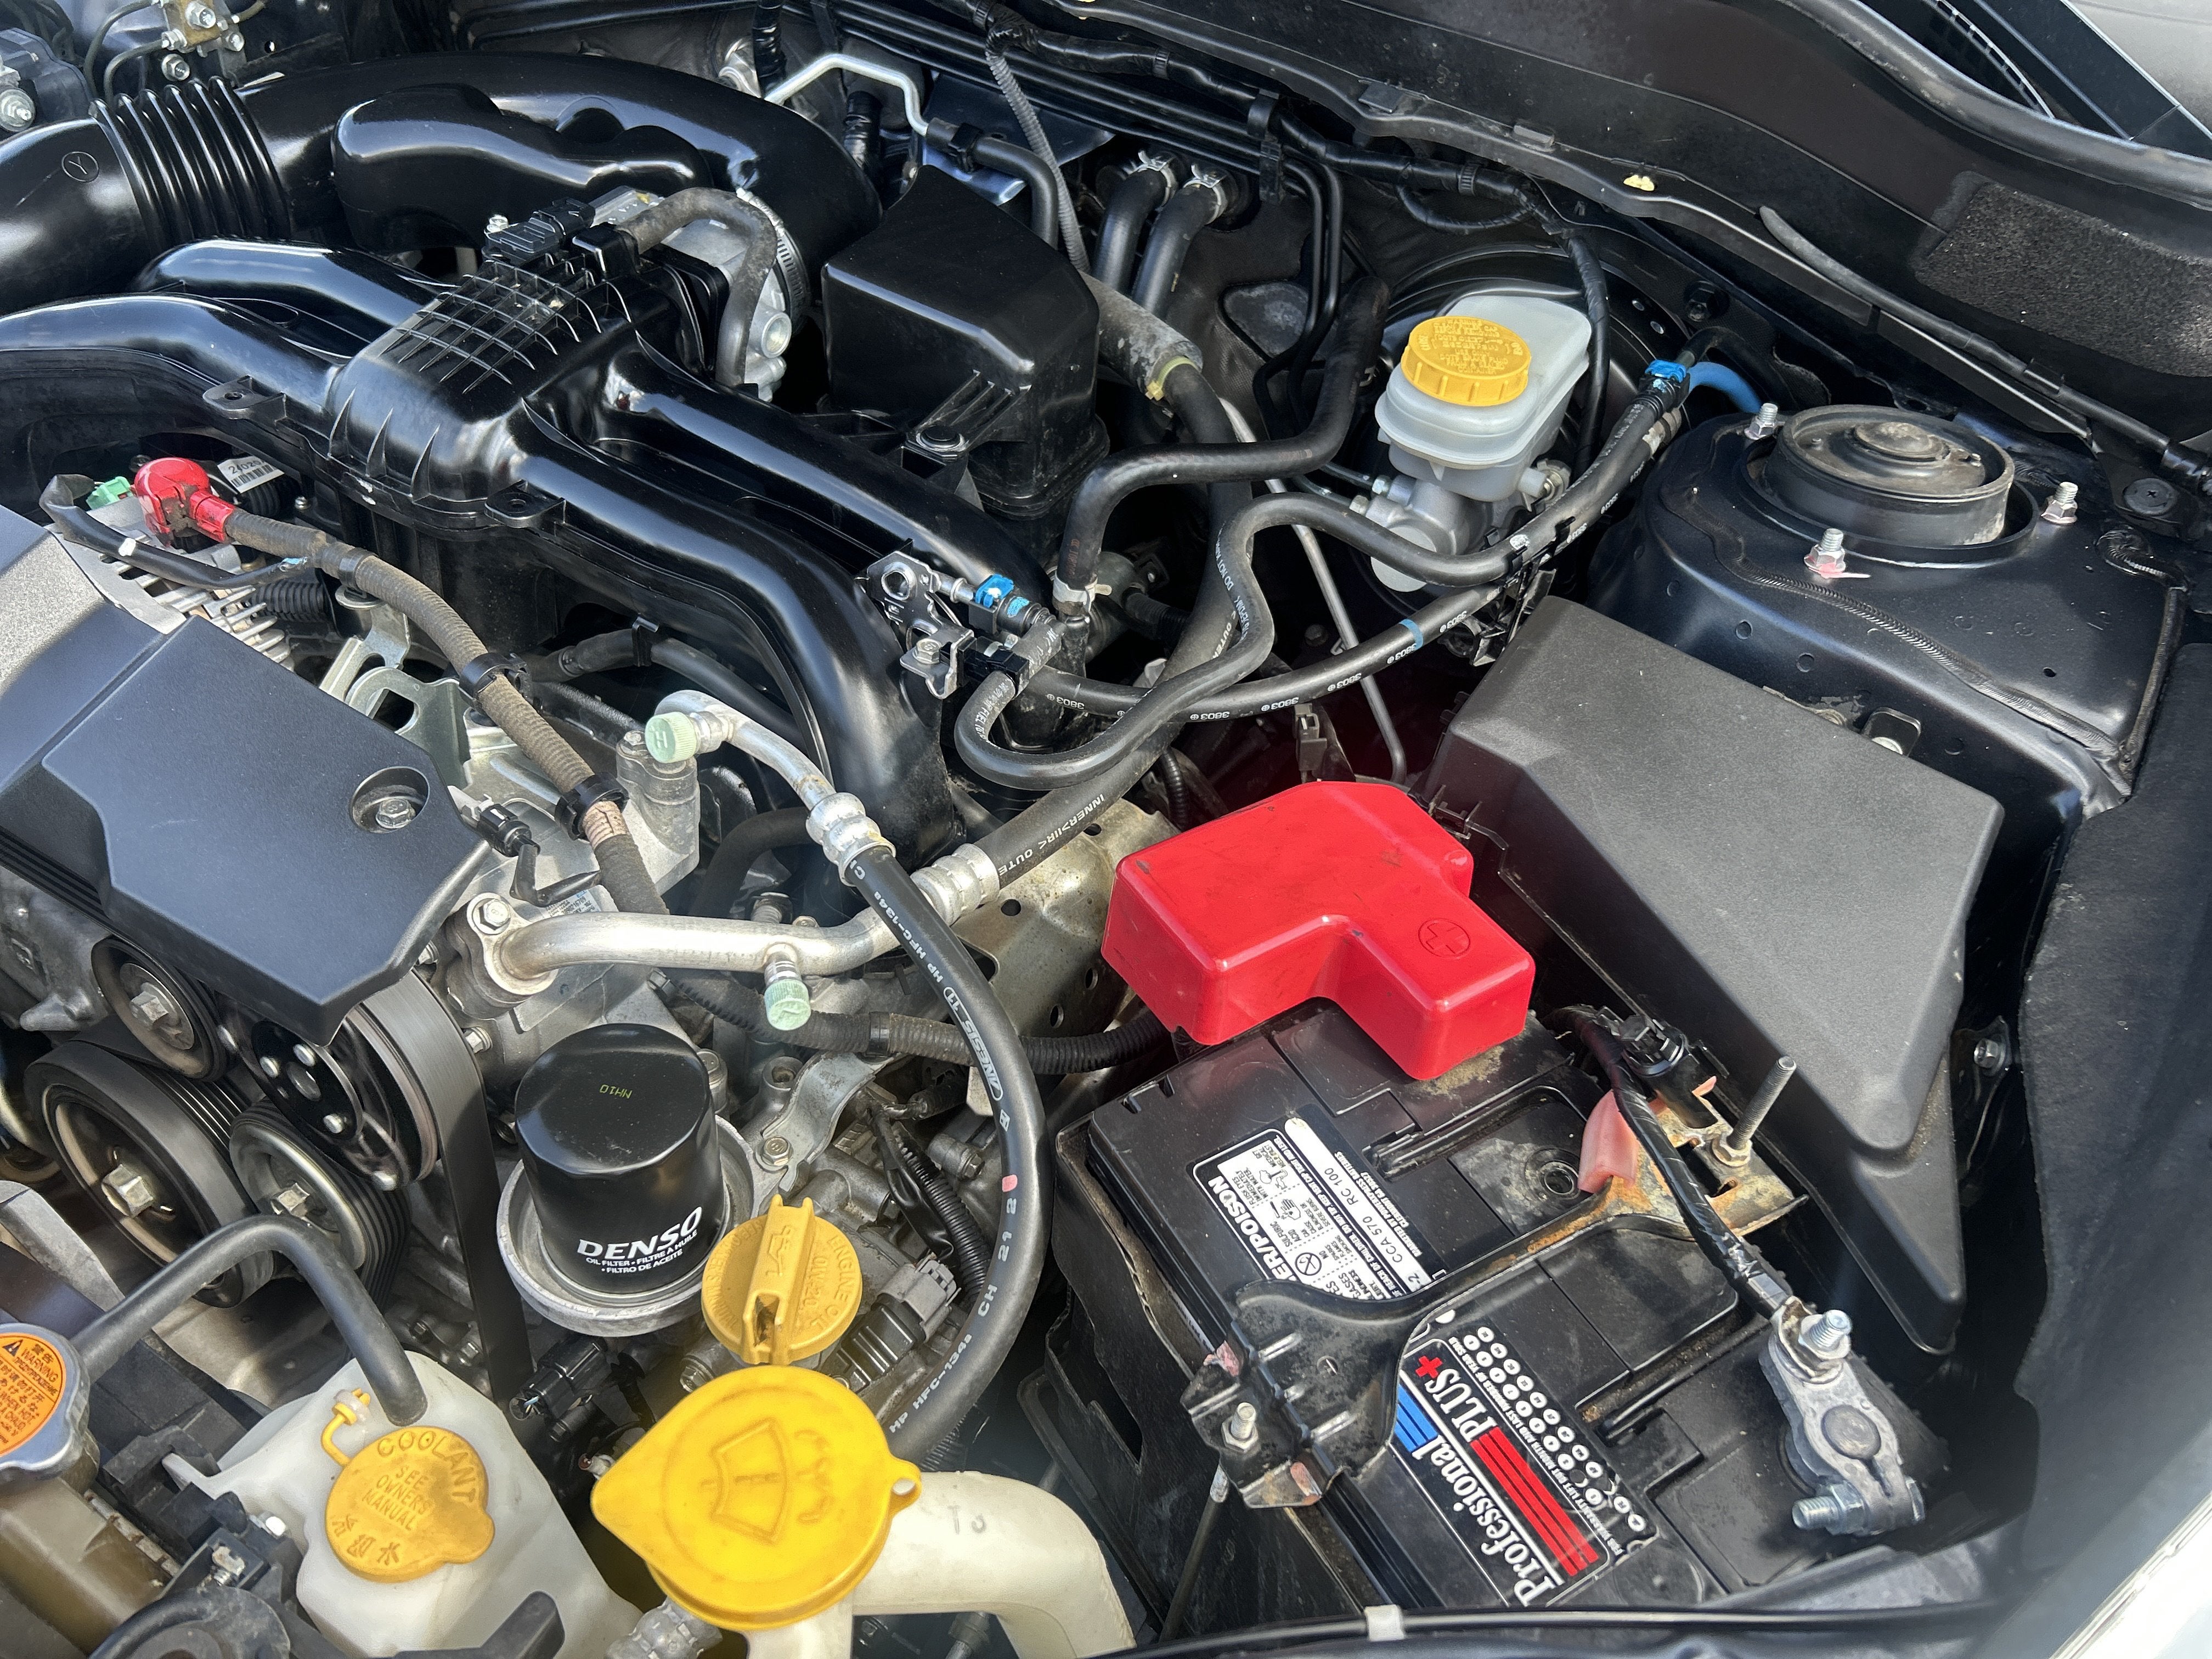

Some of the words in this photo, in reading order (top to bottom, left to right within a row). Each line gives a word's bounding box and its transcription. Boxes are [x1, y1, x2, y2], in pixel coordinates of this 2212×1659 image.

[1334, 672, 1363, 689] 3803
[1055, 696, 1085, 710] 3803
[1200, 711, 1229, 720] 3803
[1269, 696, 1300, 710] 3803
[927, 962, 943, 983] HP
[1323, 1165, 1344, 1188] 100
[1006, 1197, 1017, 1215] 2
[1339, 1186, 1359, 1207] RC
[577, 1206, 702, 1260] DENSO
[1207, 1175, 1297, 1283] ER/POISON
[1361, 1213, 1383, 1238] 570
[636, 1252, 665, 1264] FILTRE
[675, 1229, 697, 1250] HUILE
[653, 1249, 682, 1267] ACEITE
[997, 1231, 1012, 1262] 21
[1379, 1235, 1404, 1265] CCA
[827, 1235, 854, 1301] ENGINE
[978, 1284, 998, 1317] CH
[19, 1348, 60, 1384] WARNING
[889, 1411, 909, 1433] HP
[912, 1333, 972, 1410] HFC-134a
[1424, 1367, 1494, 1443] PLUS
[377, 1431, 476, 1504] COOLANT
[394, 1462, 430, 1493] SEE
[360, 1486, 419, 1531] MANUAL
[1412, 1434, 1556, 1607] Professional
